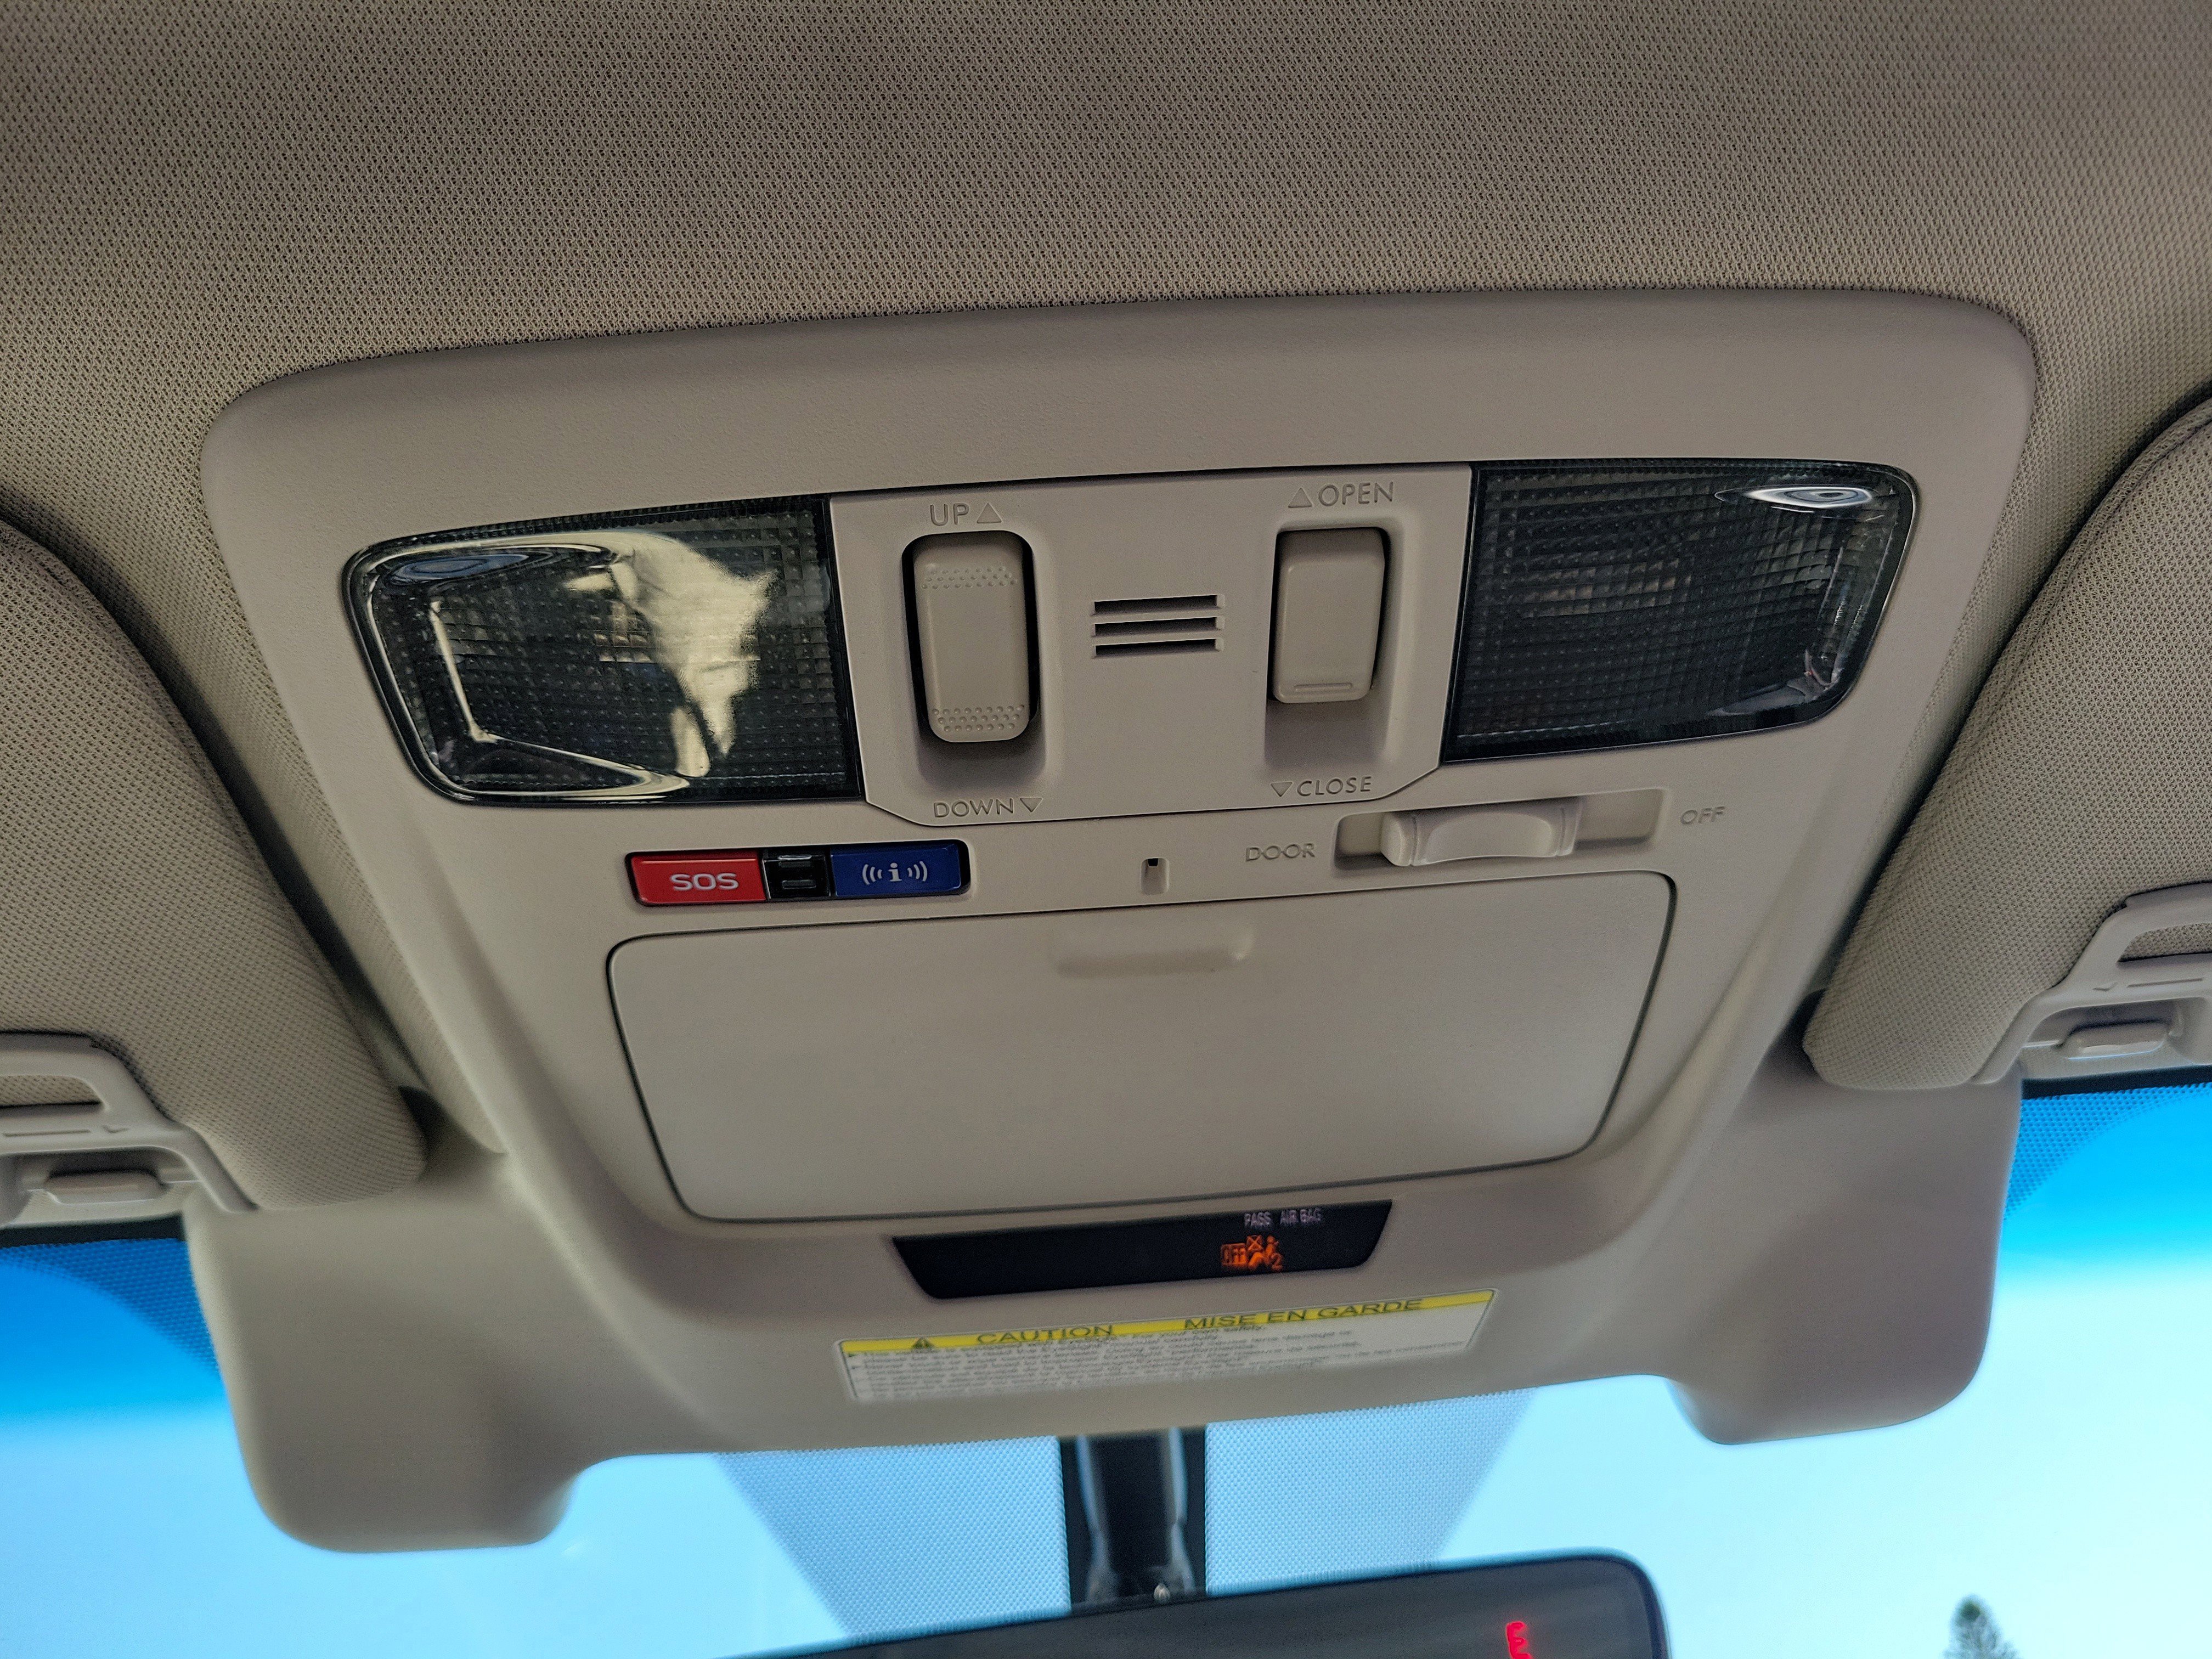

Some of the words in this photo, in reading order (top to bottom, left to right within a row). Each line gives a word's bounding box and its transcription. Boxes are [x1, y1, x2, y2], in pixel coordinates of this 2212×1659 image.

[1318, 481, 1394, 506] OPEN
[929, 503, 969, 526] UP
[1296, 776, 1372, 798] CLOSE
[933, 797, 1014, 819] DOWN
[1680, 805, 1726, 826] OFF
[1245, 842, 1316, 862] DOOR
[669, 872, 740, 891] SOS
[1244, 1211, 1272, 1227] PASS
[977, 1324, 1113, 1345] CAUTION
[1184, 1313, 1258, 1330] MISE
[1268, 1308, 1307, 1322] EN
[1317, 1298, 1423, 1318] GARDE
